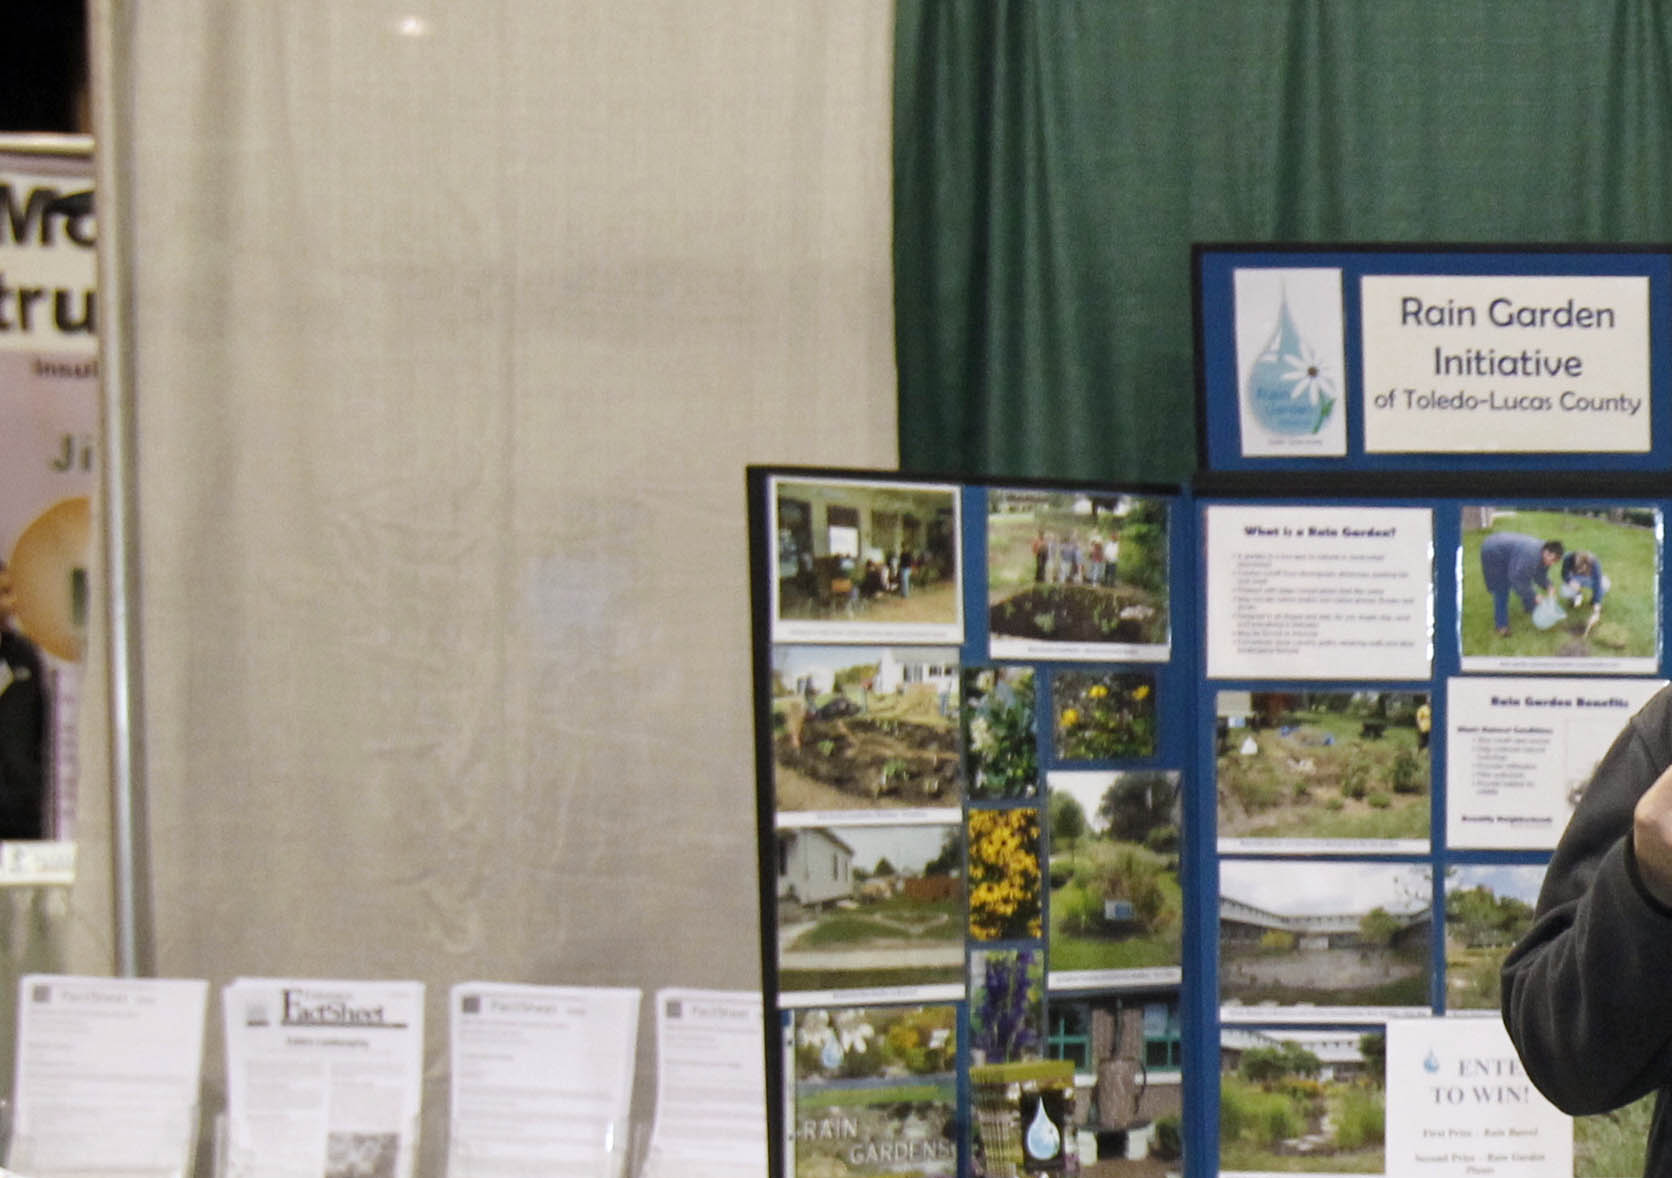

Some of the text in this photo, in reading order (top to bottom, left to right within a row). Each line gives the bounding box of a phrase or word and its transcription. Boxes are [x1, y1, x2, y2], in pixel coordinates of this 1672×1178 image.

[1400, 296, 1615, 329] Rain Garden
[1434, 347, 1583, 377] Initiative
[1374, 388, 1642, 416] of Toledo-Lucas County
[1243, 525, 1279, 537] What
[1308, 527, 1338, 537] Rain
[1433, 1086, 1529, 1104] TO WIN!
[803, 1117, 858, 1141] RAIN
